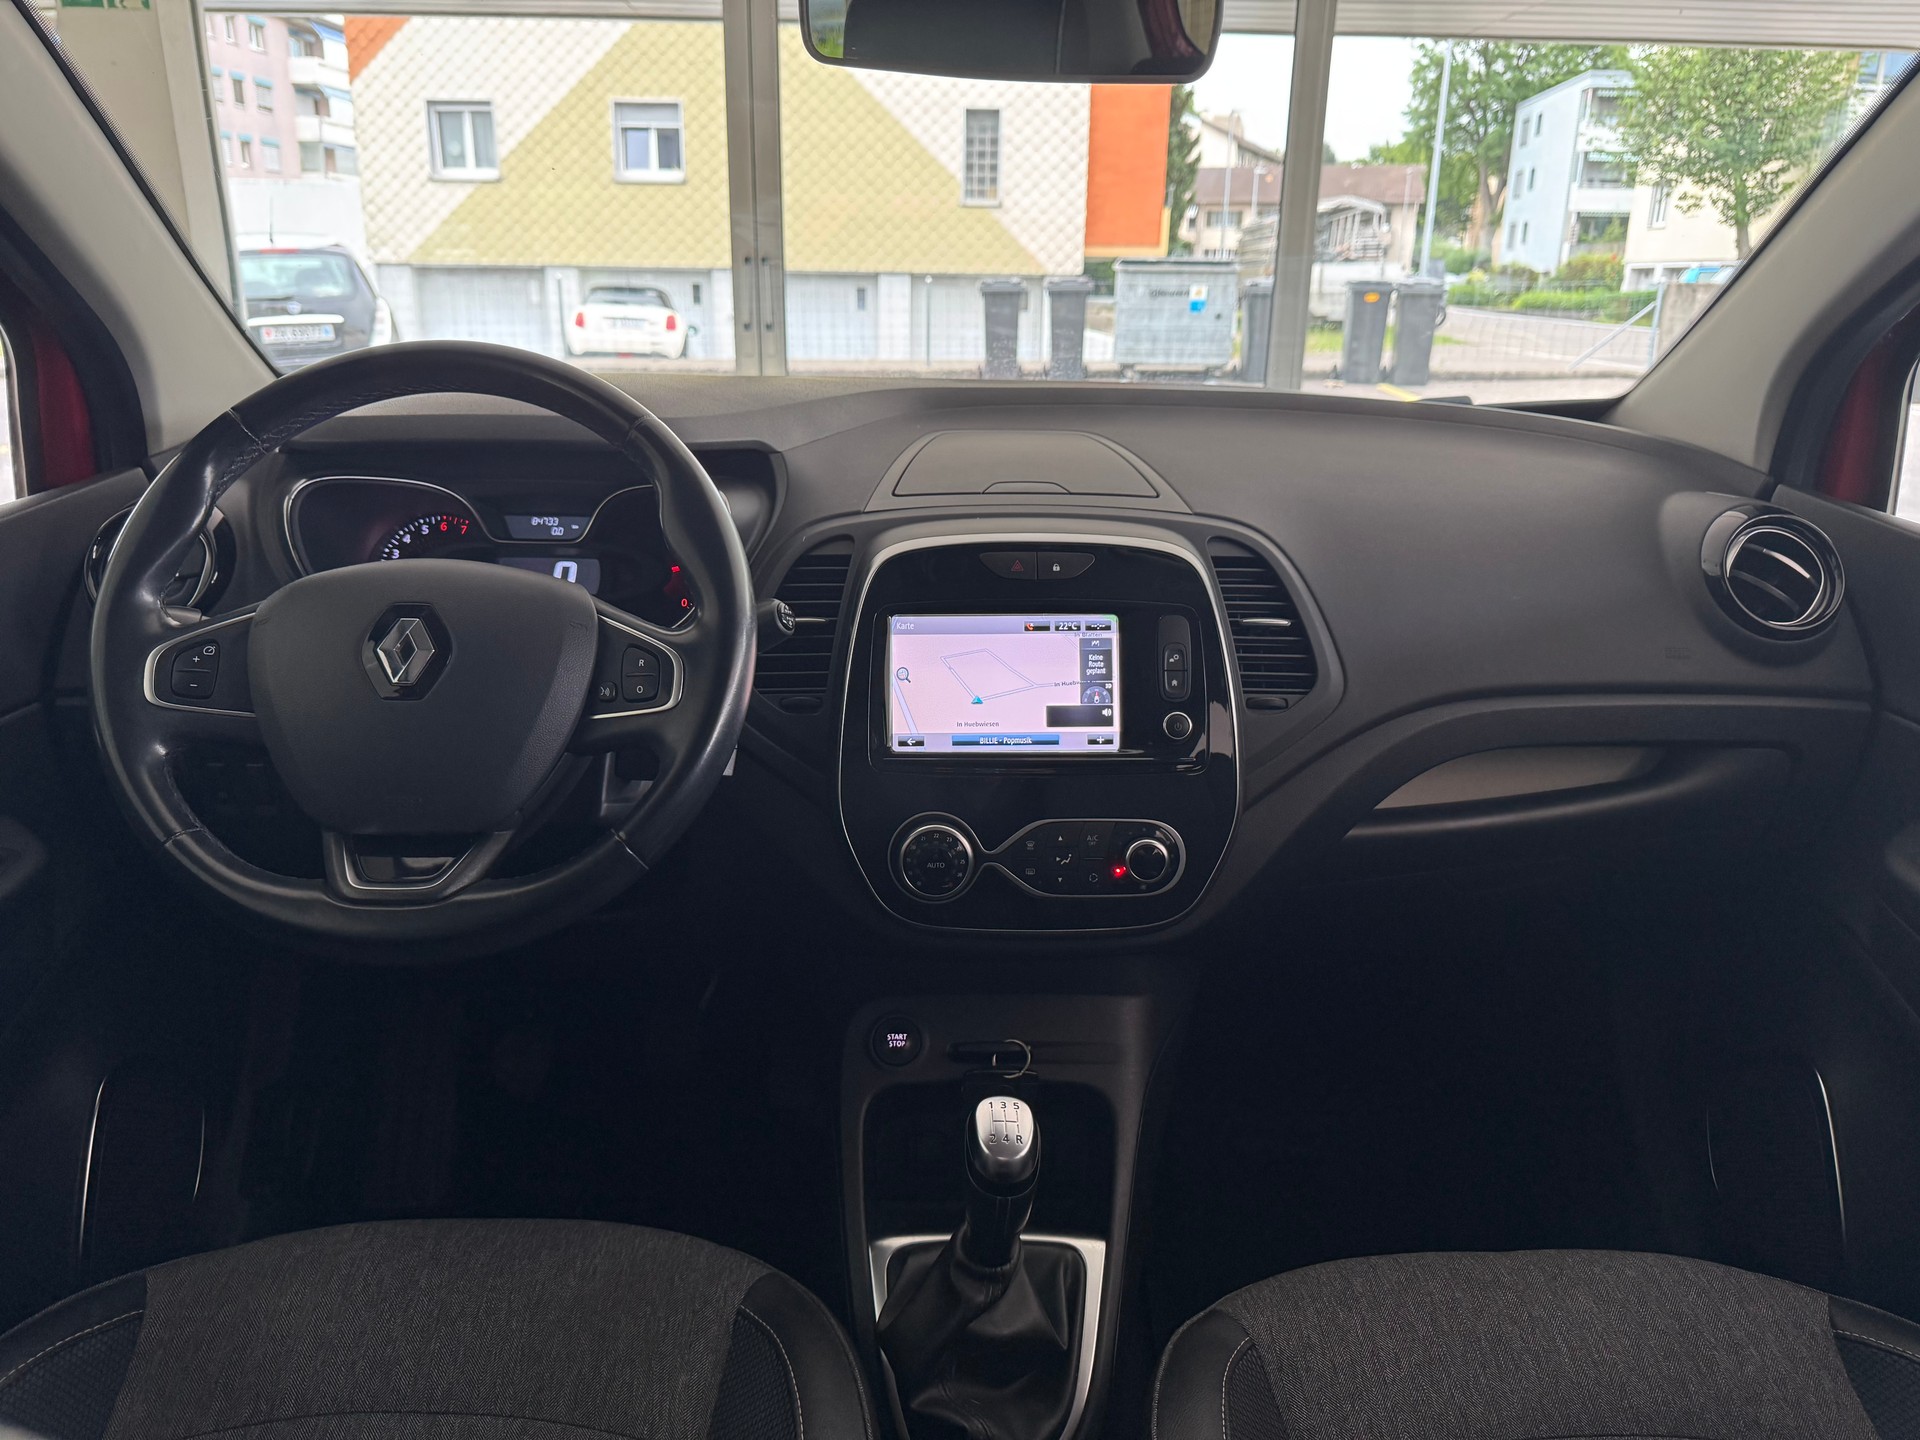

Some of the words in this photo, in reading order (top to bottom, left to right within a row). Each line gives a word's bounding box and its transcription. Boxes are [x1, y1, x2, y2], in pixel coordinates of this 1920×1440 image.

[421, 525, 429, 535] 5
[440, 521, 448, 532] 6
[460, 525, 469, 535] 7
[401, 534, 411, 544] 4
[391, 550, 400, 559] 3
[896, 622, 915, 631] Karte
[638, 659, 645, 667] R
[1086, 667, 1106, 676] geplant
[1003, 736, 1033, 746] Popmusik
[1086, 834, 1099, 842] A/C
[887, 1033, 908, 1041] START
[888, 1040, 906, 1048] STOP
[988, 1101, 994, 1109] 1
[1000, 1101, 1007, 1109] 3
[1013, 1102, 1020, 1110] 5
[989, 1134, 997, 1145] 2
[1002, 1134, 1010, 1144] 4
[1015, 1134, 1024, 1145] R
